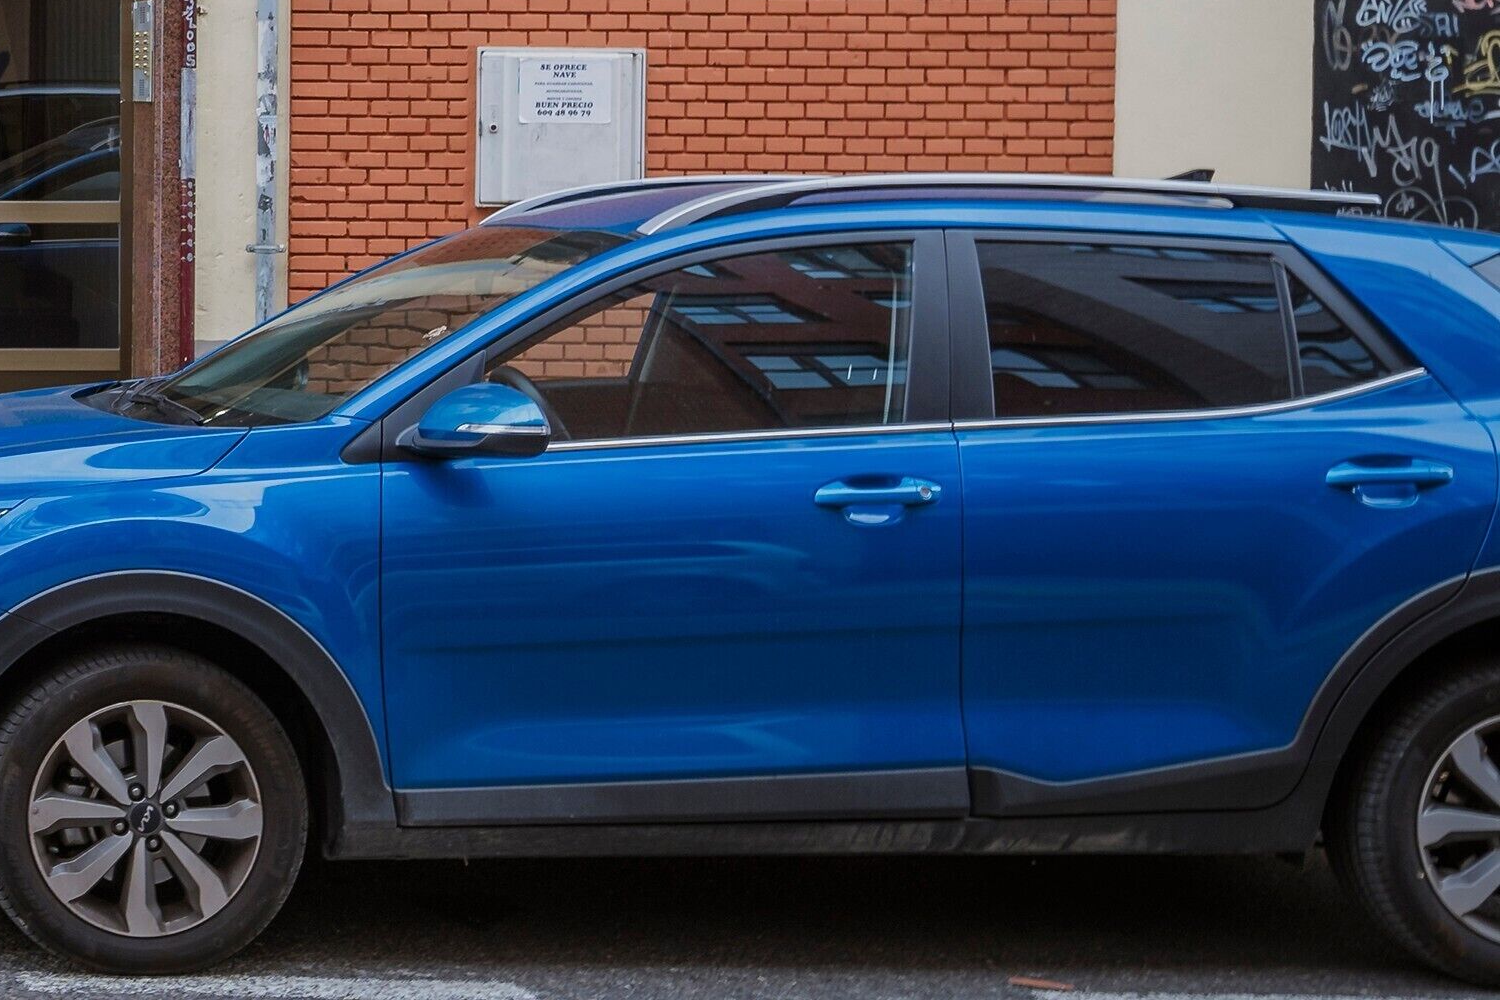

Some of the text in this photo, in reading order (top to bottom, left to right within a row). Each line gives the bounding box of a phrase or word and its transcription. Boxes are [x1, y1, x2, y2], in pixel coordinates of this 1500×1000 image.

[535, 101, 594, 109] BUEN PRECIO
[537, 109, 592, 117] 609 48 96 79
